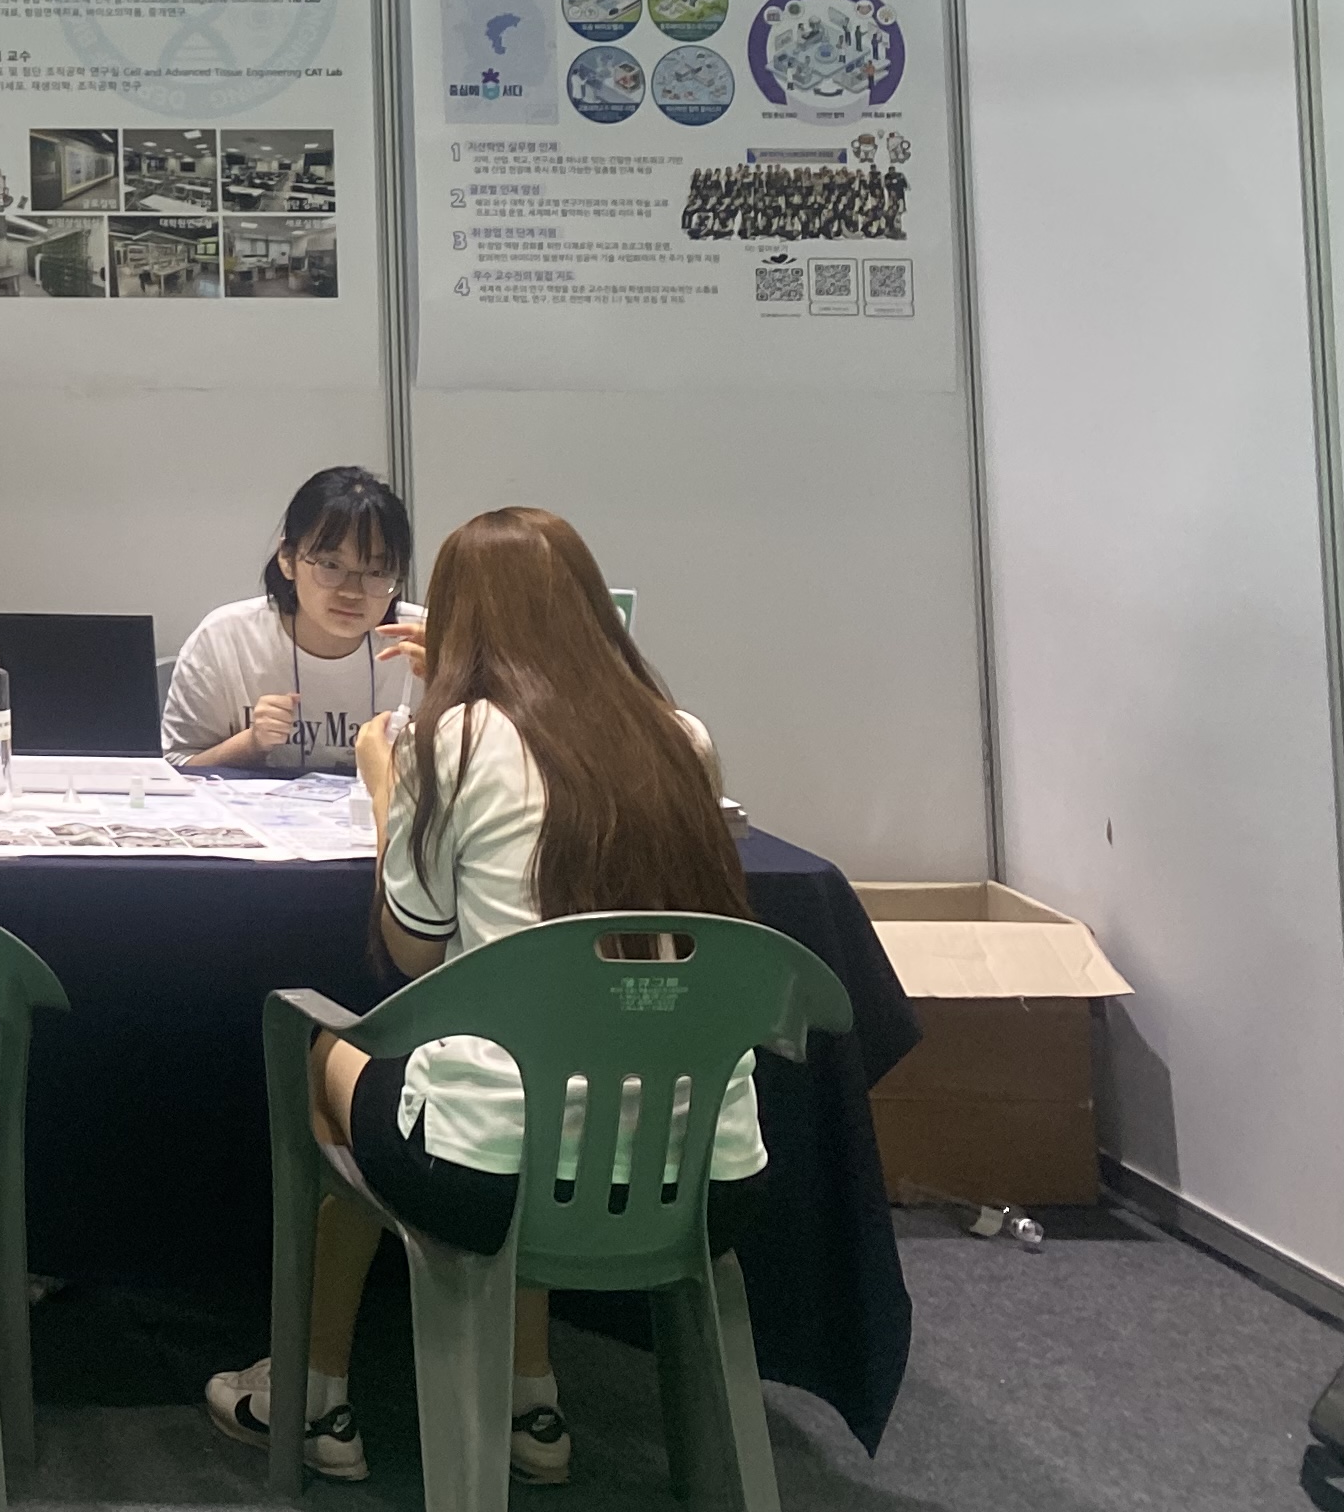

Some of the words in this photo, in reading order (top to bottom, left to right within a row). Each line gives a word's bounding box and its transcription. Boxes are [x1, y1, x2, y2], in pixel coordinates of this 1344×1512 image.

[7, 50, 31, 63] 교수
[450, 142, 461, 162] 1
[450, 188, 467, 208] 2
[453, 231, 468, 250] 3
[454, 276, 471, 296] 4
